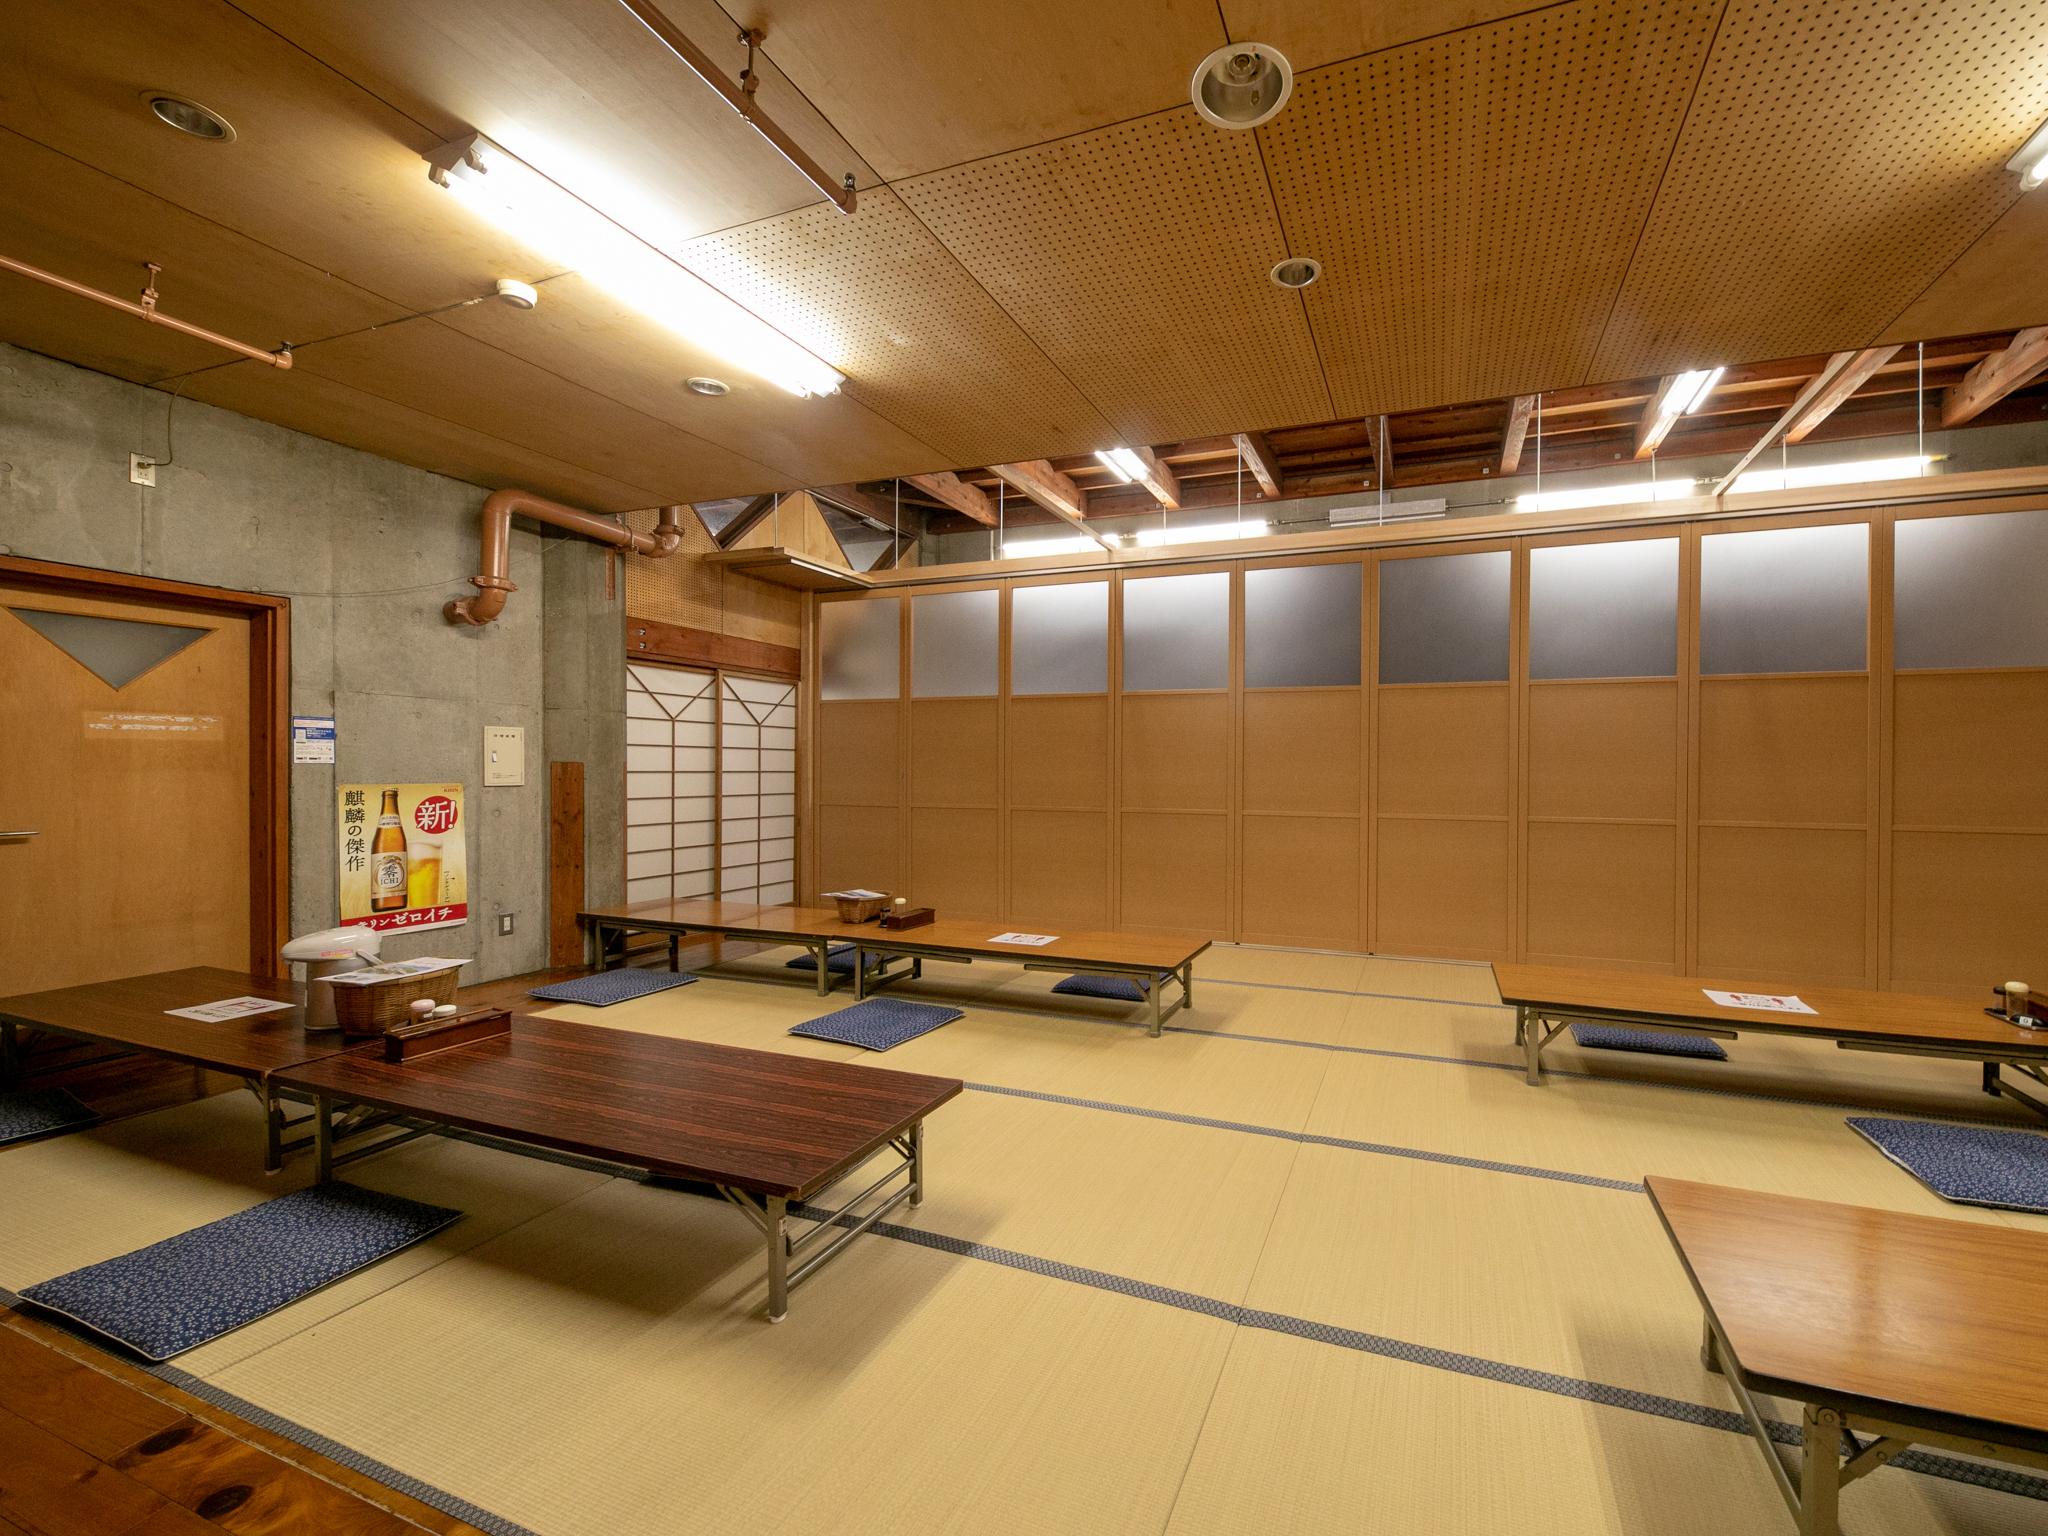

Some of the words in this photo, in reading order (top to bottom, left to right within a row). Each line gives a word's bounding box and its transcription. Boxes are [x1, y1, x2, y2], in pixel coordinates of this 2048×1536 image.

[344, 790, 365, 872] 麒麟の傑作
[380, 877, 399, 886] ICHI
